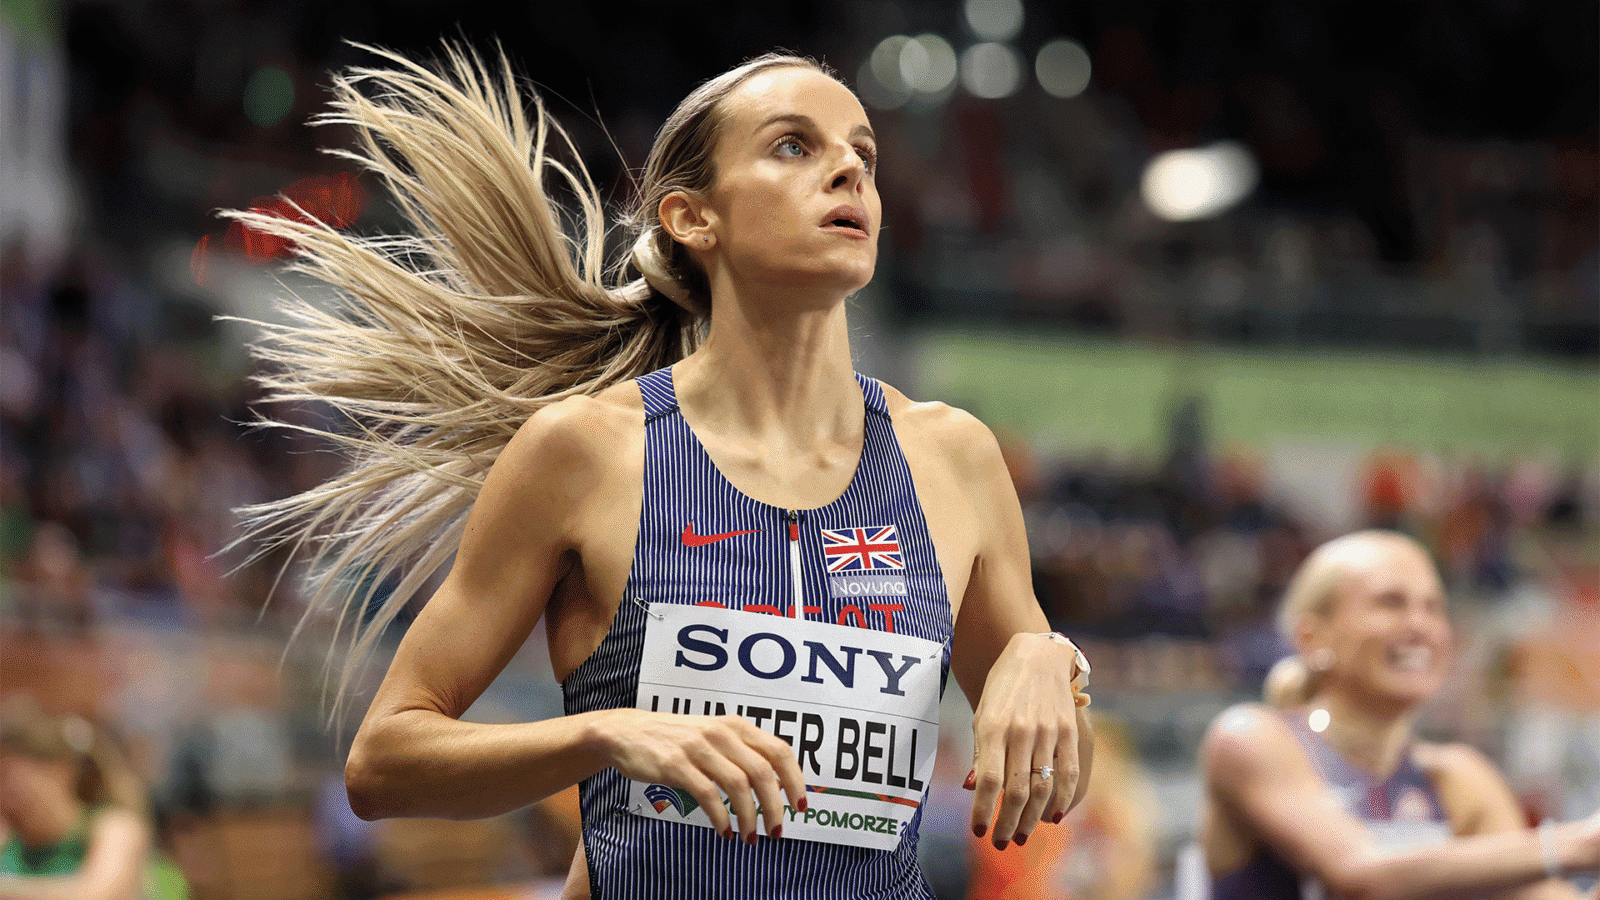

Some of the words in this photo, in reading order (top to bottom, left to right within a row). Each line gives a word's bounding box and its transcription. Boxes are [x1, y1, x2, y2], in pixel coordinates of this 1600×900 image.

[832, 578, 907, 596] Novuna
[674, 624, 921, 697] SONY
[835, 717, 924, 792] BELL
[804, 808, 899, 836] POMORZE
